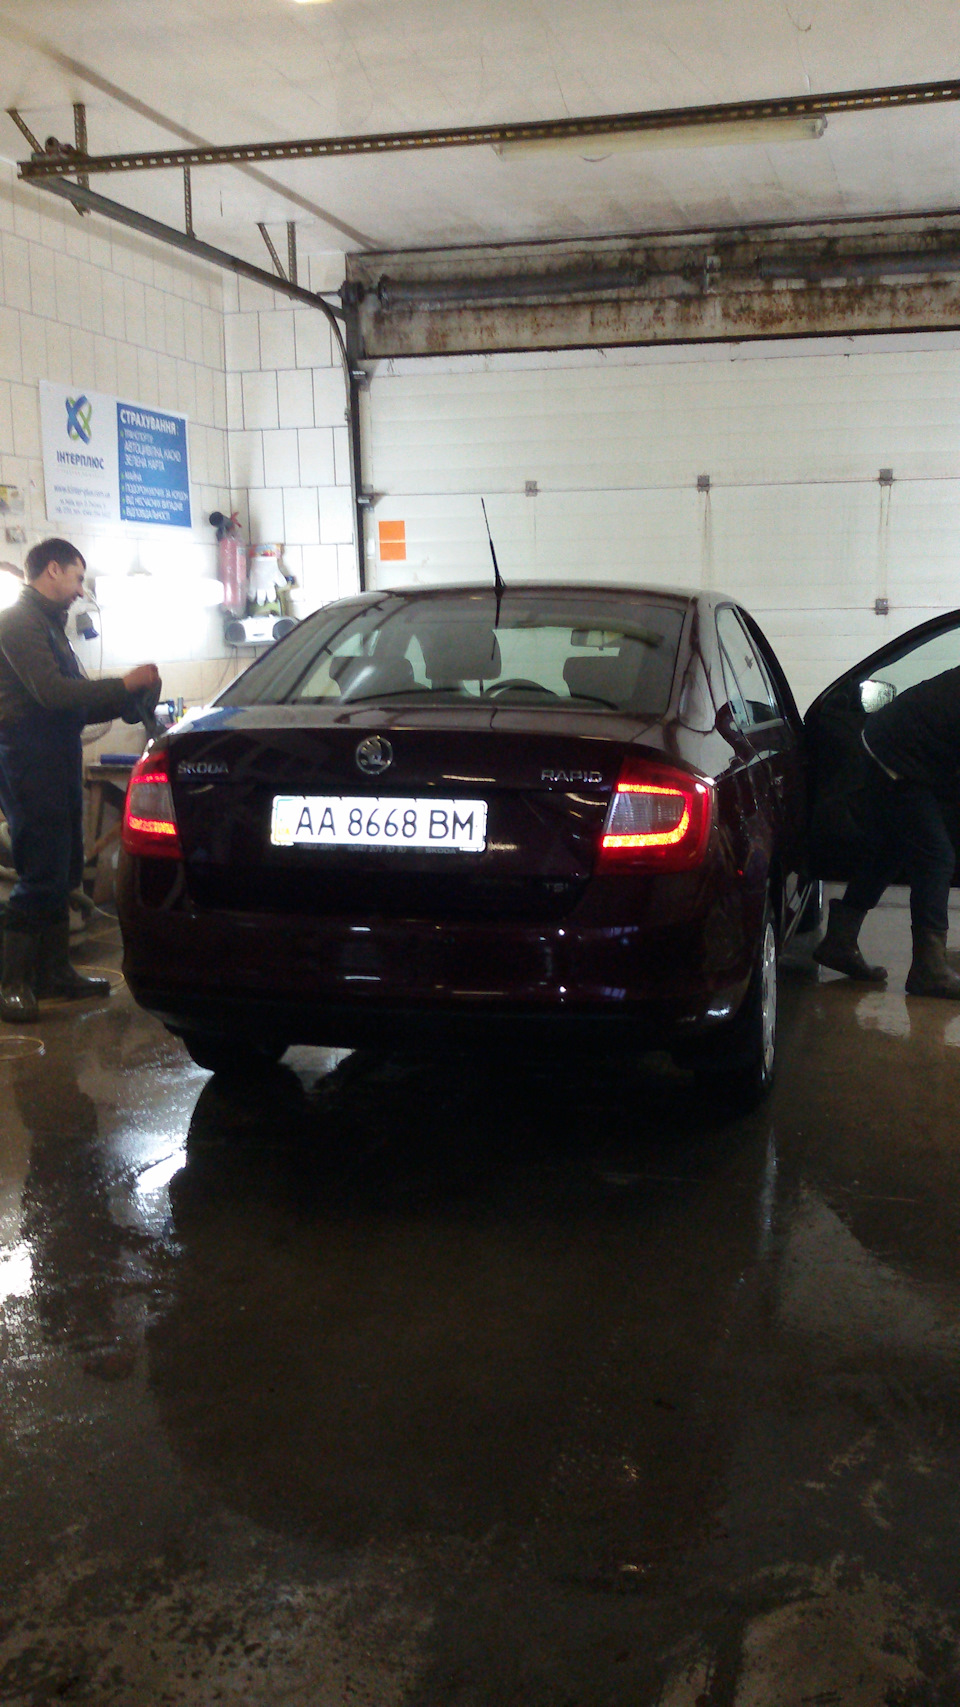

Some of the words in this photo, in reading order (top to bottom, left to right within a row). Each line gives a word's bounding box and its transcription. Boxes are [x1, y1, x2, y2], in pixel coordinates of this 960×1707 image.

[57, 450, 104, 470] ІНТЕРПЛЮС
[541, 768, 602, 784] RAPID
[296, 807, 336, 836] AA
[348, 808, 417, 838] 8668
[428, 810, 474, 840] BM
